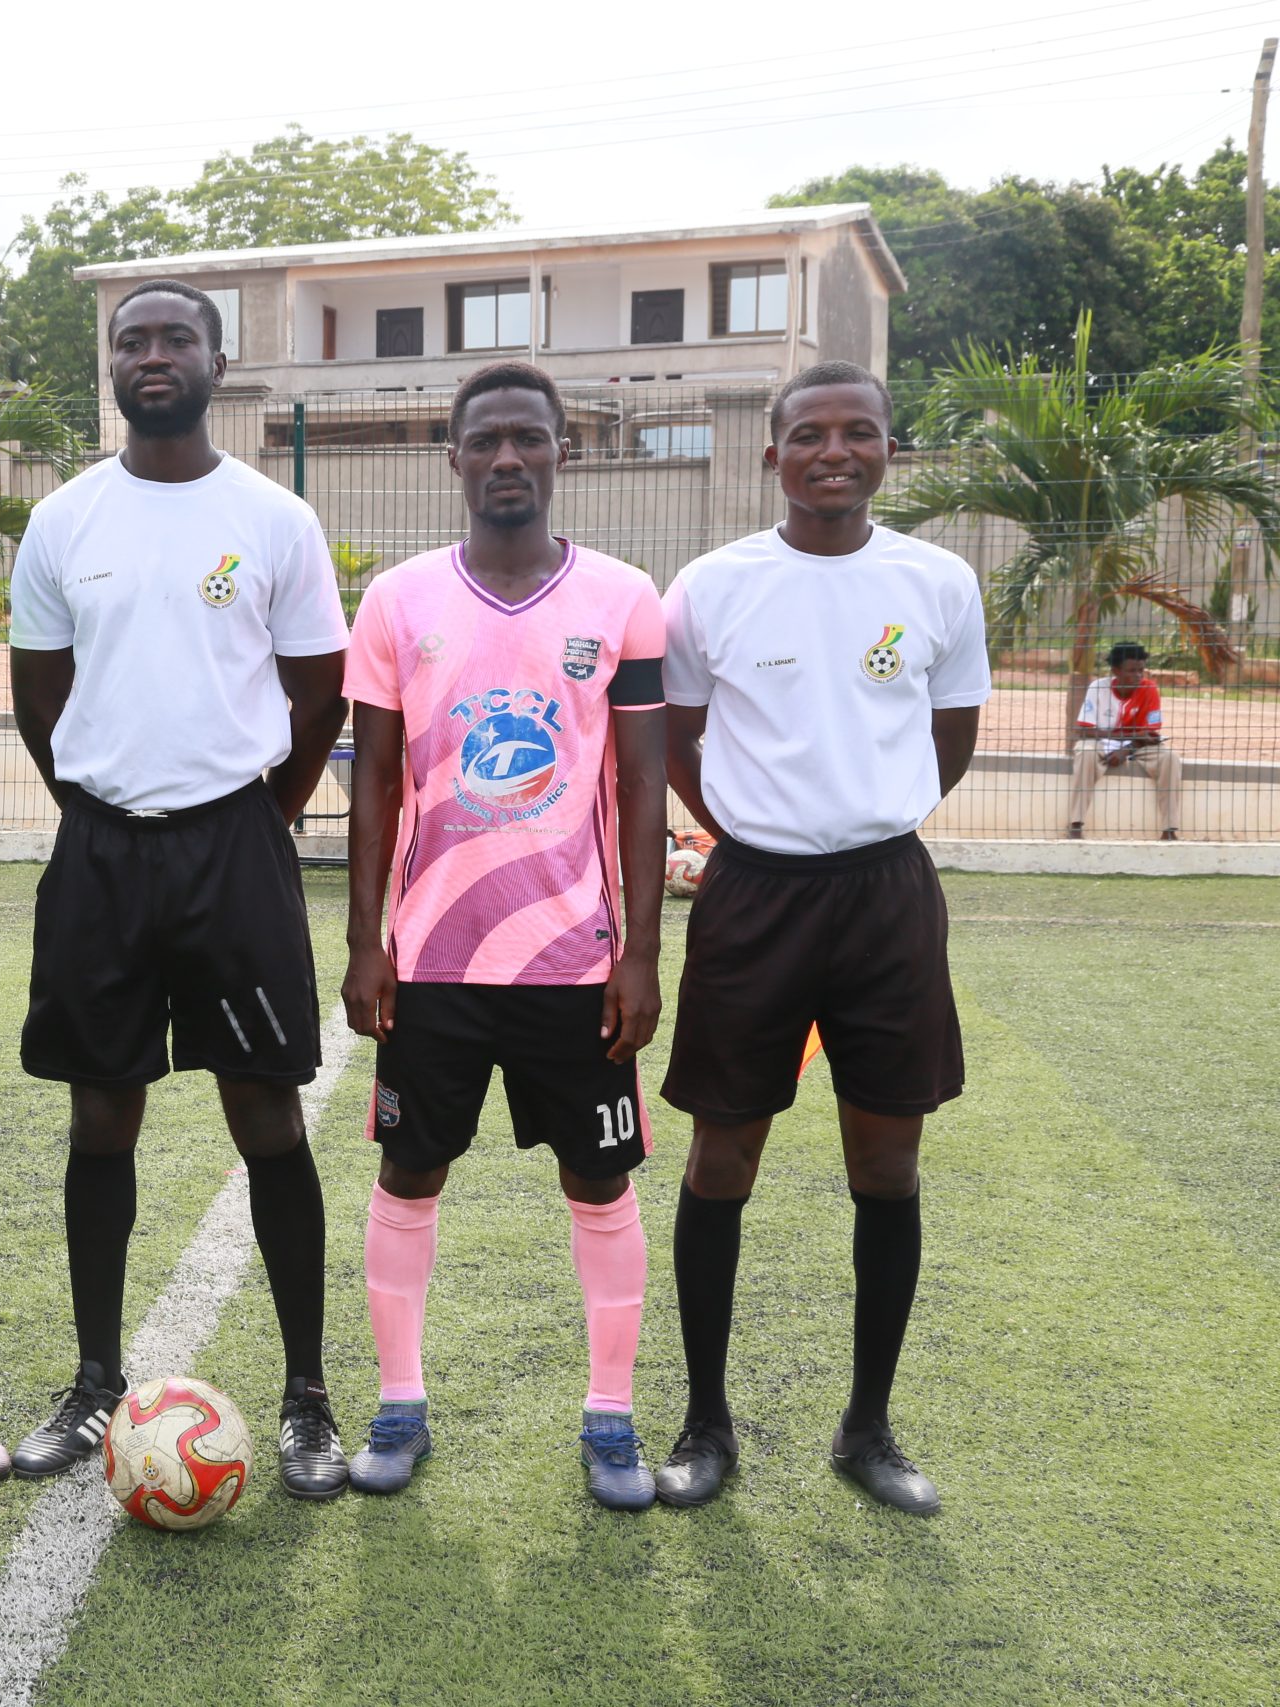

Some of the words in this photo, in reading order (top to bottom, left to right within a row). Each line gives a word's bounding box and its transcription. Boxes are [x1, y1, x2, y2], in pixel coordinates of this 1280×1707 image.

[92, 571, 112, 580] ASHANTI
[774, 657, 796, 666] ASHANTI
[448, 688, 564, 734] TCCL
[513, 781, 568, 821] Logistics
[596, 1095, 635, 1149] 10
